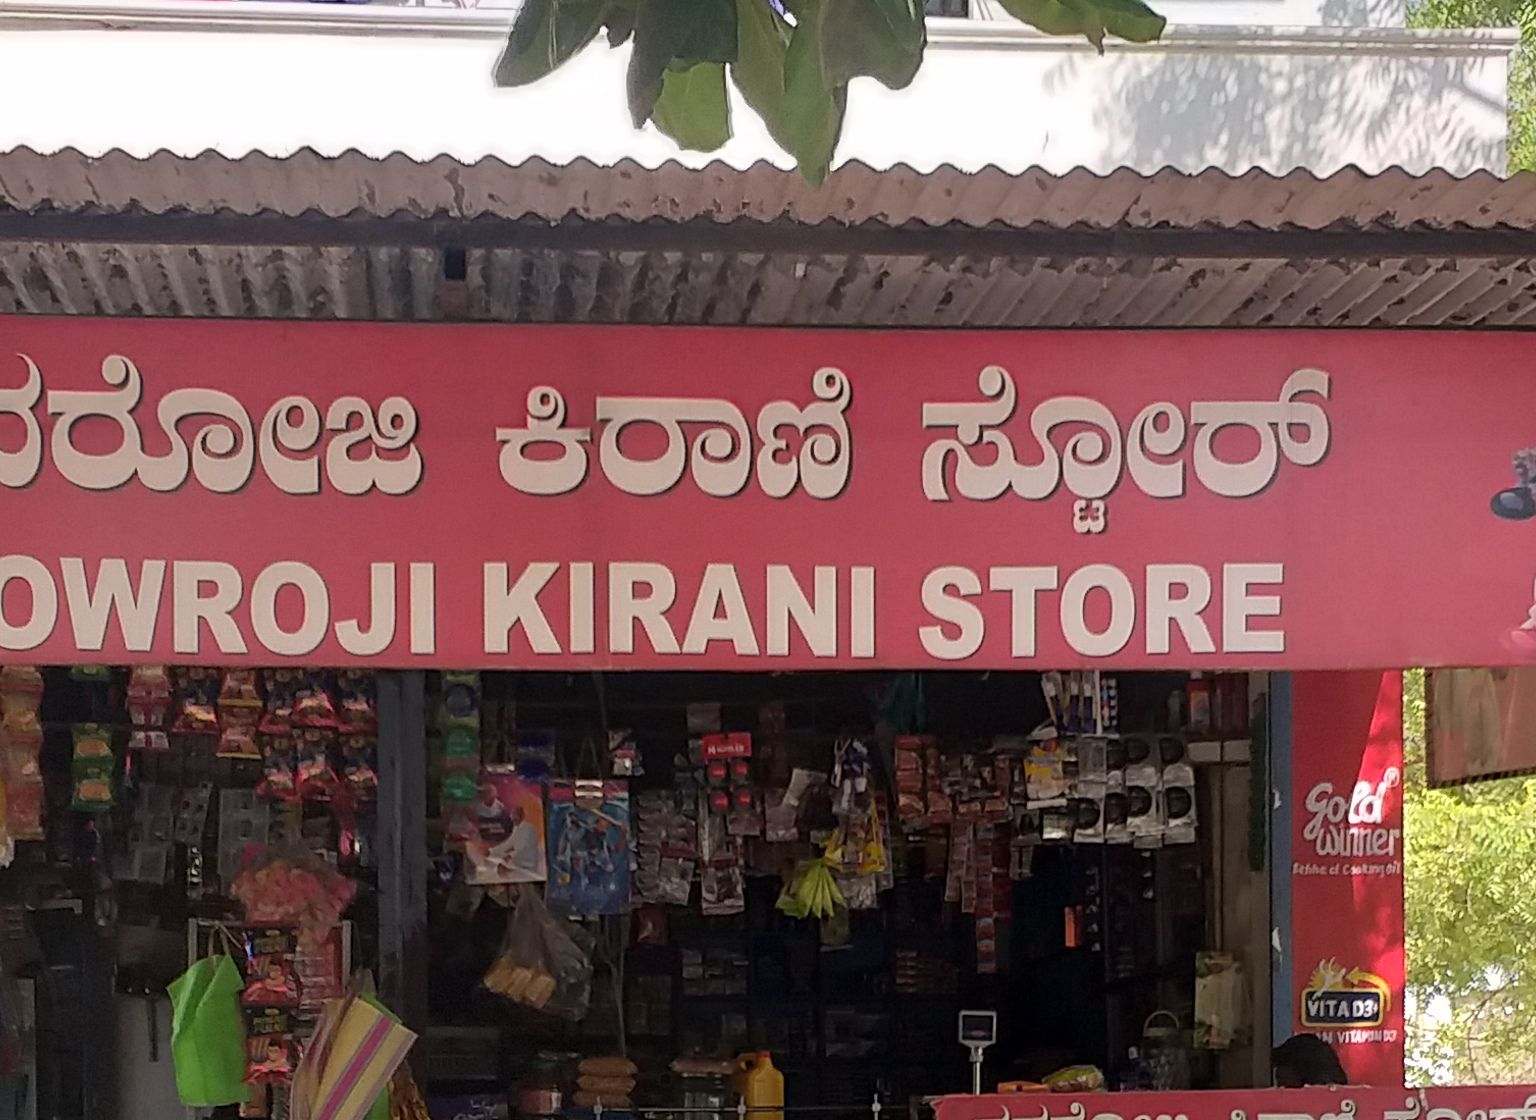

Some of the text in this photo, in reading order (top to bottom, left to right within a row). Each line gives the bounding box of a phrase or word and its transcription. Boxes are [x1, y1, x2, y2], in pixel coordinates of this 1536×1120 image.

[495, 366, 852, 499] ಕಿರಾಣಿ
[920, 363, 1330, 535] ಸ್ಟೋರ್
[481, 561, 875, 658] KIRANI
[917, 561, 1288, 659] STORE
